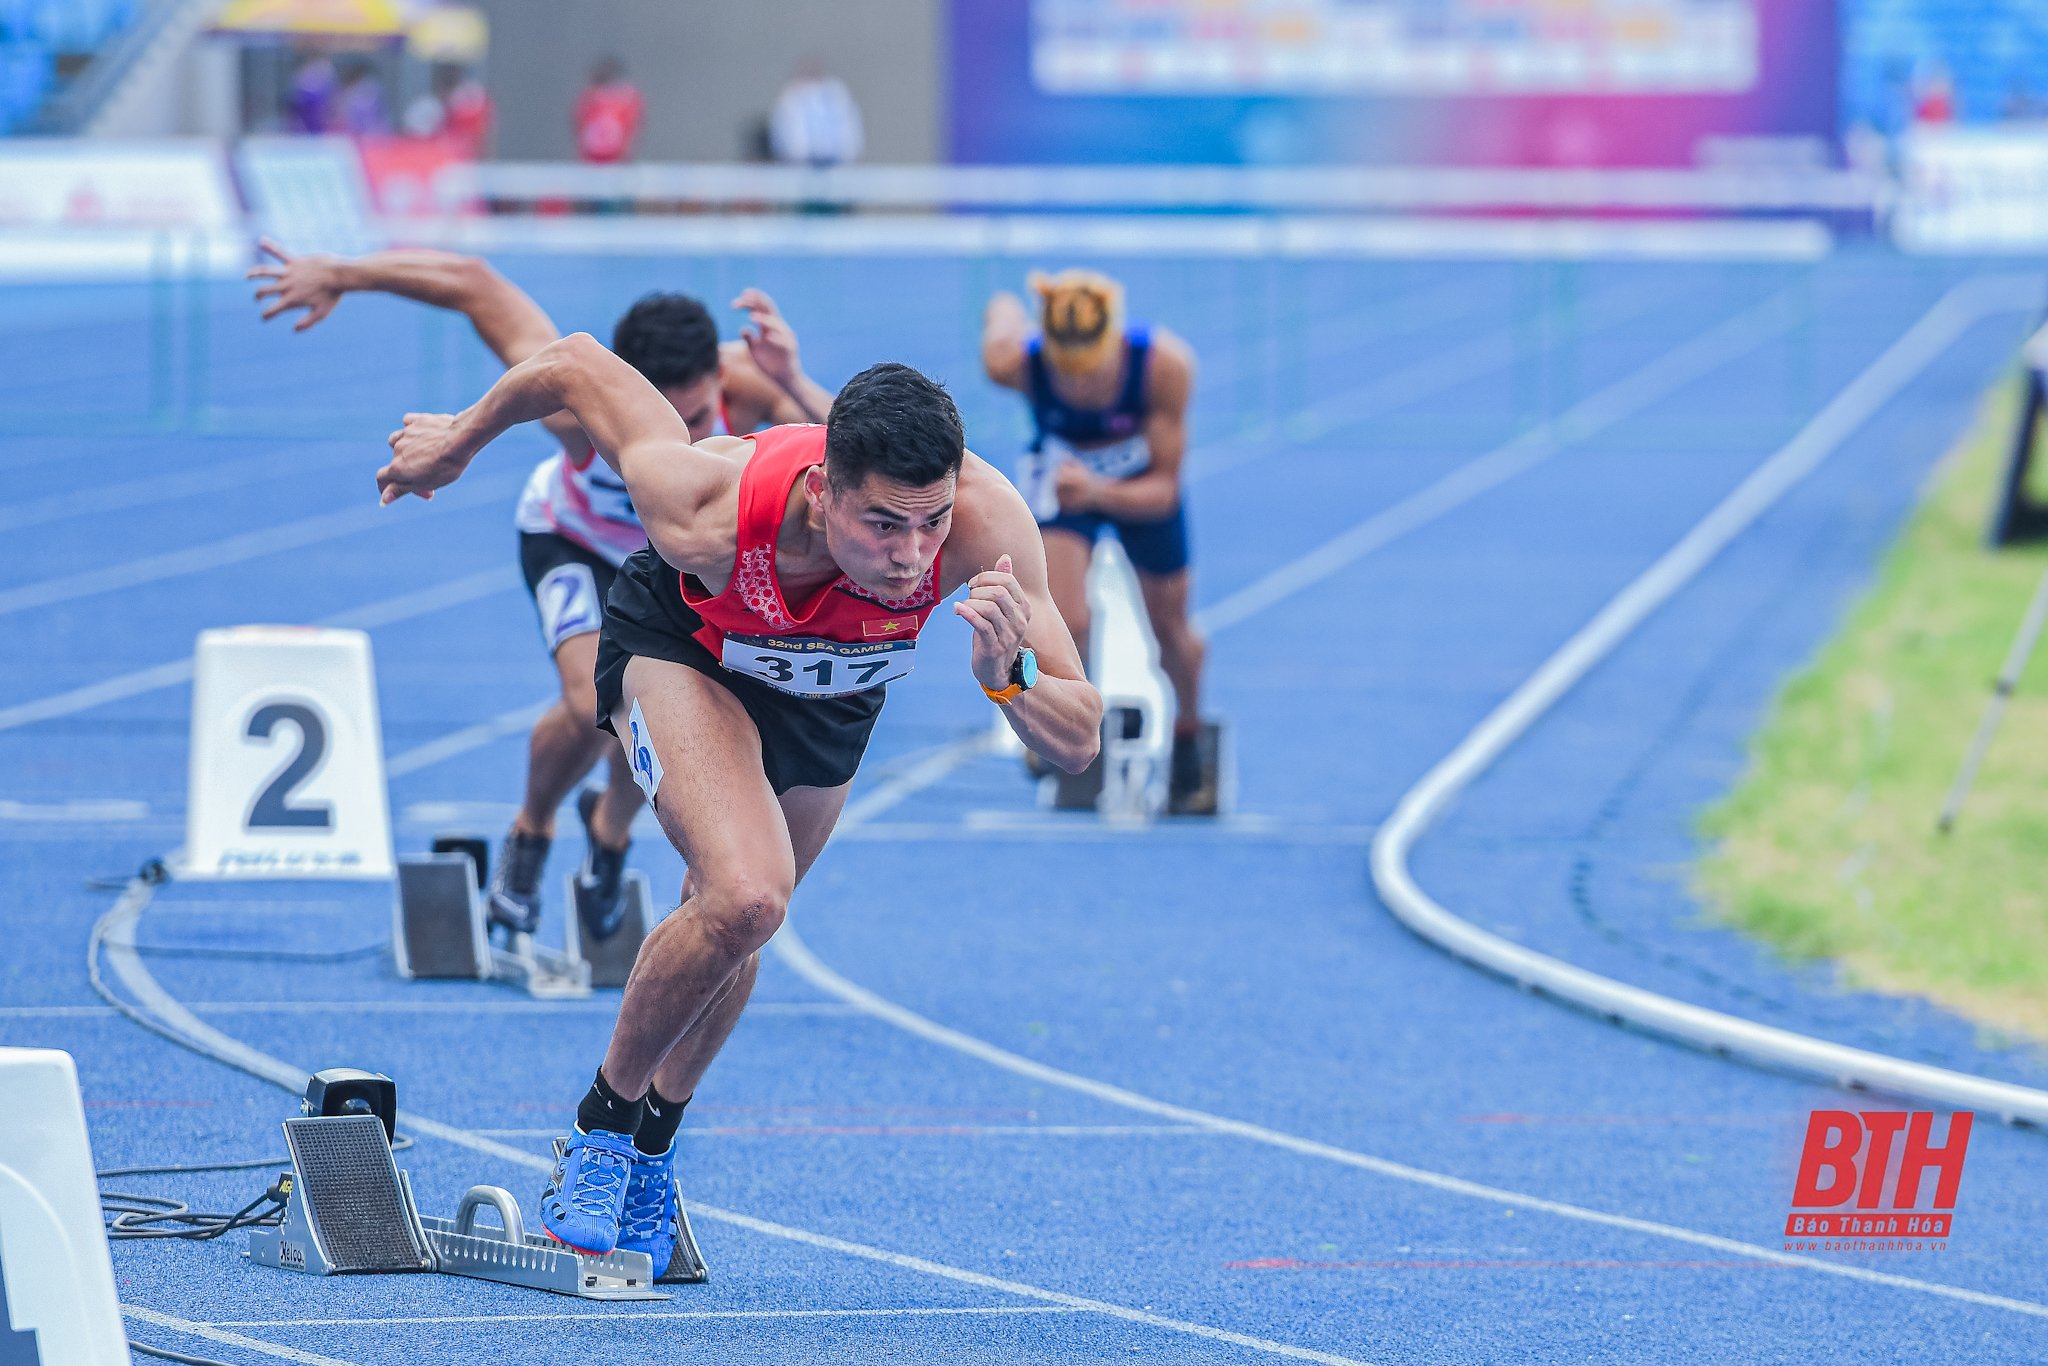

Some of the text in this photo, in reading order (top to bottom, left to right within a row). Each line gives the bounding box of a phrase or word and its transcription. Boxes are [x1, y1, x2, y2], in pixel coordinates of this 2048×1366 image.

[551, 575, 588, 635] 2
[768, 639, 803, 650] 32nd
[806, 642, 835, 652] SEA
[840, 643, 894, 655] GAMES
[754, 656, 890, 686] 317
[246, 702, 332, 828] 2
